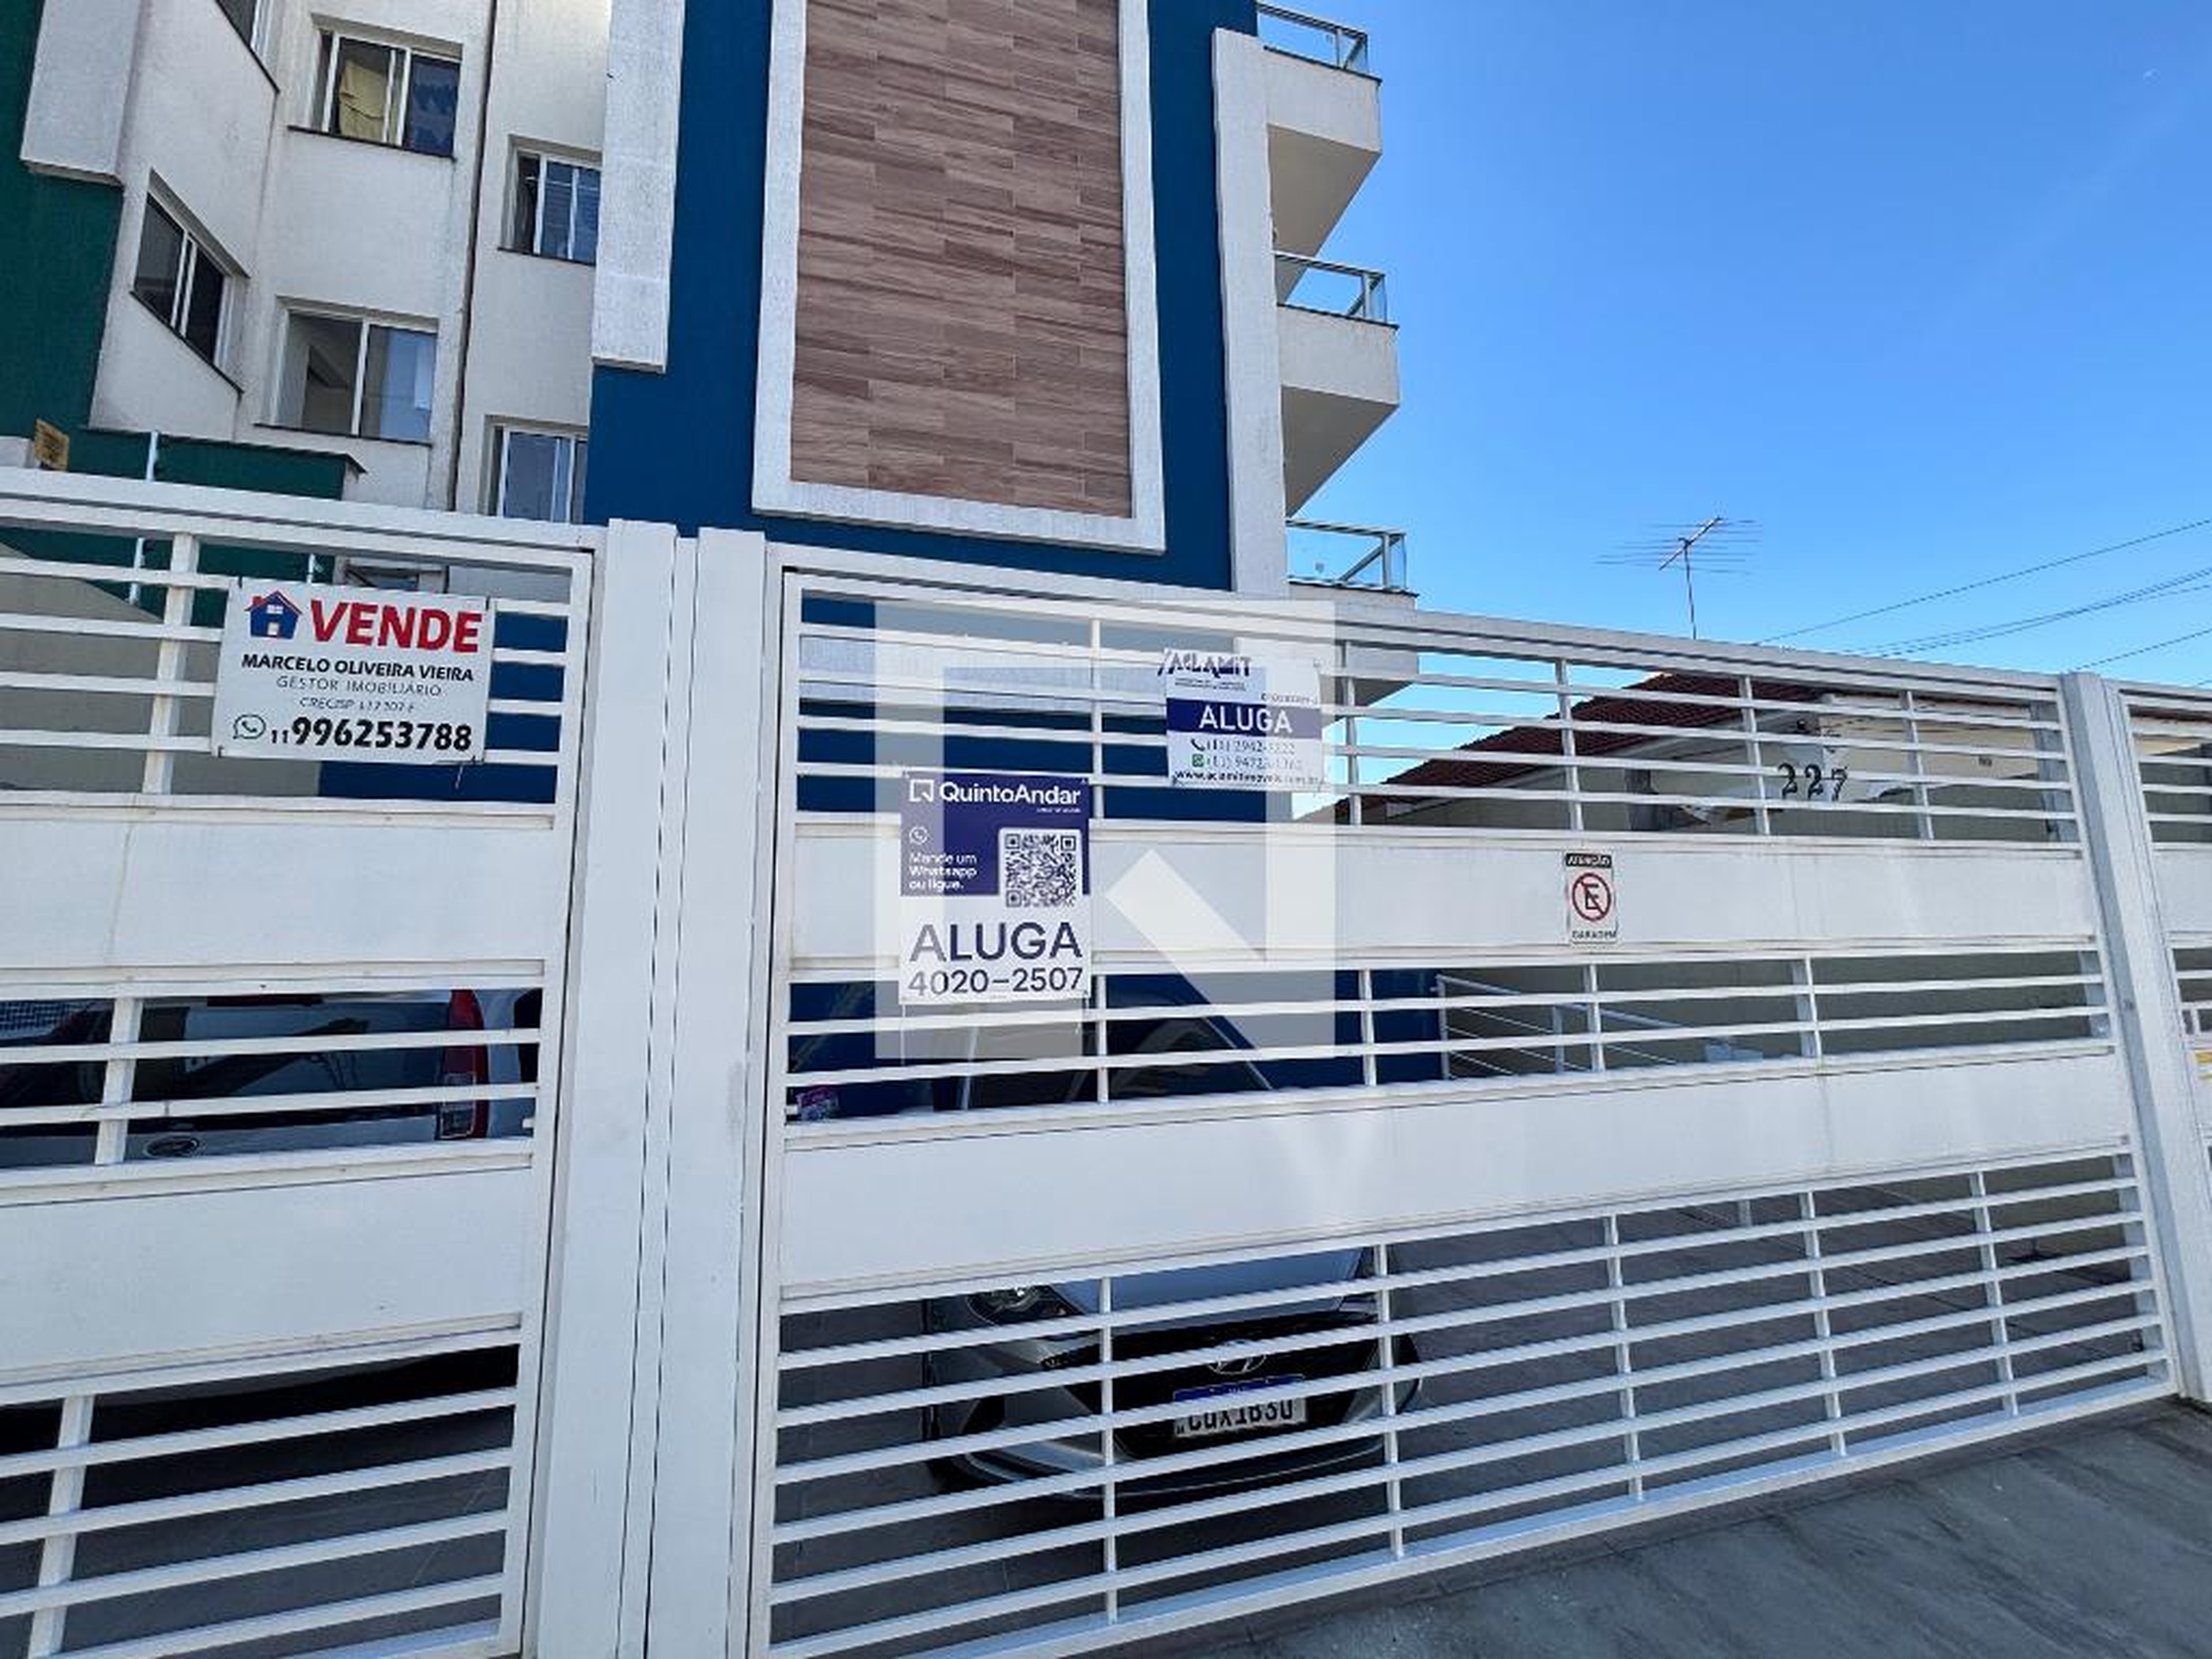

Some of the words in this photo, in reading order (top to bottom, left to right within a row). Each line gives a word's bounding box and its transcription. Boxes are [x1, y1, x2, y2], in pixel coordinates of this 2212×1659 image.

[310, 600, 482, 653] VENDE
[242, 654, 329, 672] MARCELO
[335, 660, 415, 678] OLIVEIRA
[419, 665, 474, 681] VIEIRA
[276, 676, 339, 692] GESTOR
[1199, 704, 1293, 733] ALUGA
[271, 729, 288, 744] 11
[291, 717, 472, 751] 996253788
[940, 781, 1081, 805] QuintoAndar
[1778, 762, 1848, 801] 227
[909, 866, 978, 880] Whatsapp
[910, 852, 954, 865] Mande
[956, 854, 978, 865] um
[909, 922, 1083, 962] ALUGA
[908, 967, 1083, 997] 4020-2507
